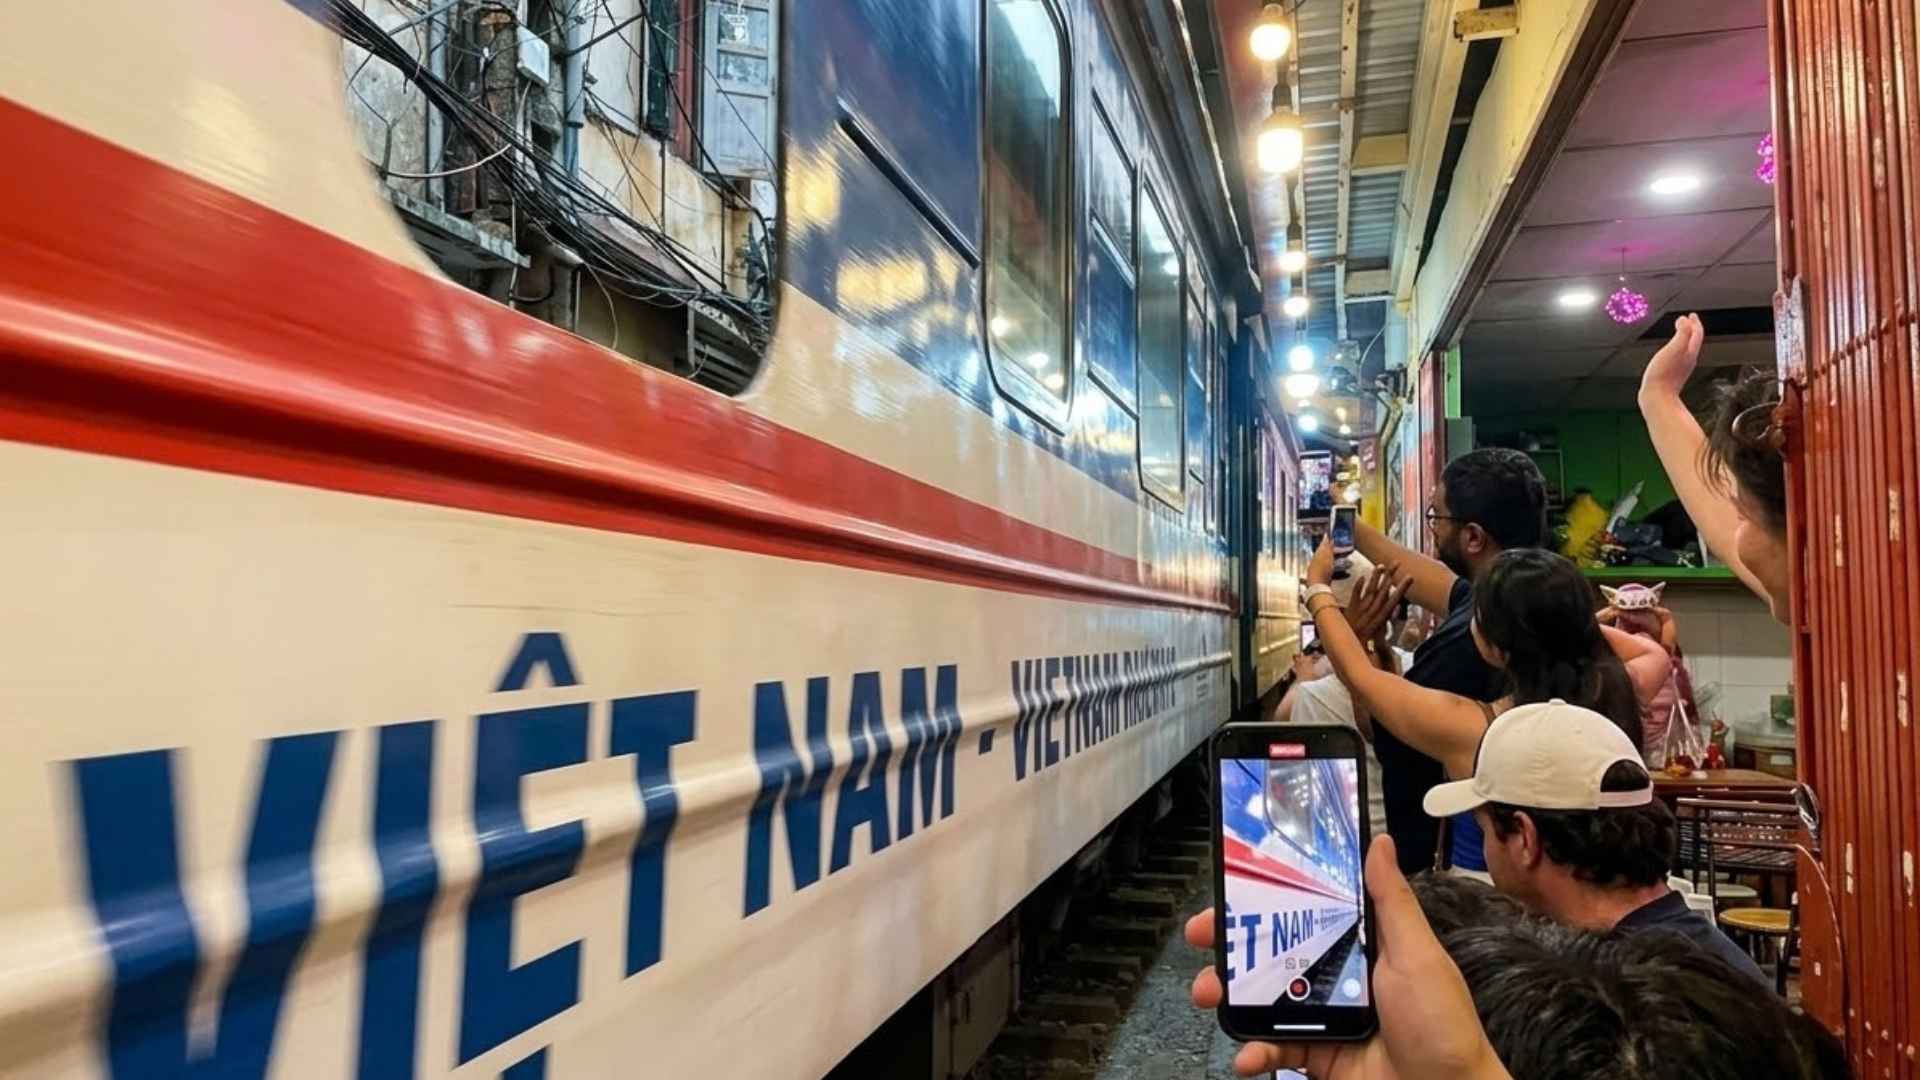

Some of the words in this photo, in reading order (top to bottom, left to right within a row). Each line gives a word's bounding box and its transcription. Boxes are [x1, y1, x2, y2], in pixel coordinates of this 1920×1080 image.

[60, 632, 698, 1080] VIỆT
[742, 664, 962, 918] NAM
[978, 728, 996, 755] -
[1012, 652, 1120, 782] VIETNAM
[1272, 909, 1314, 958] NAM
